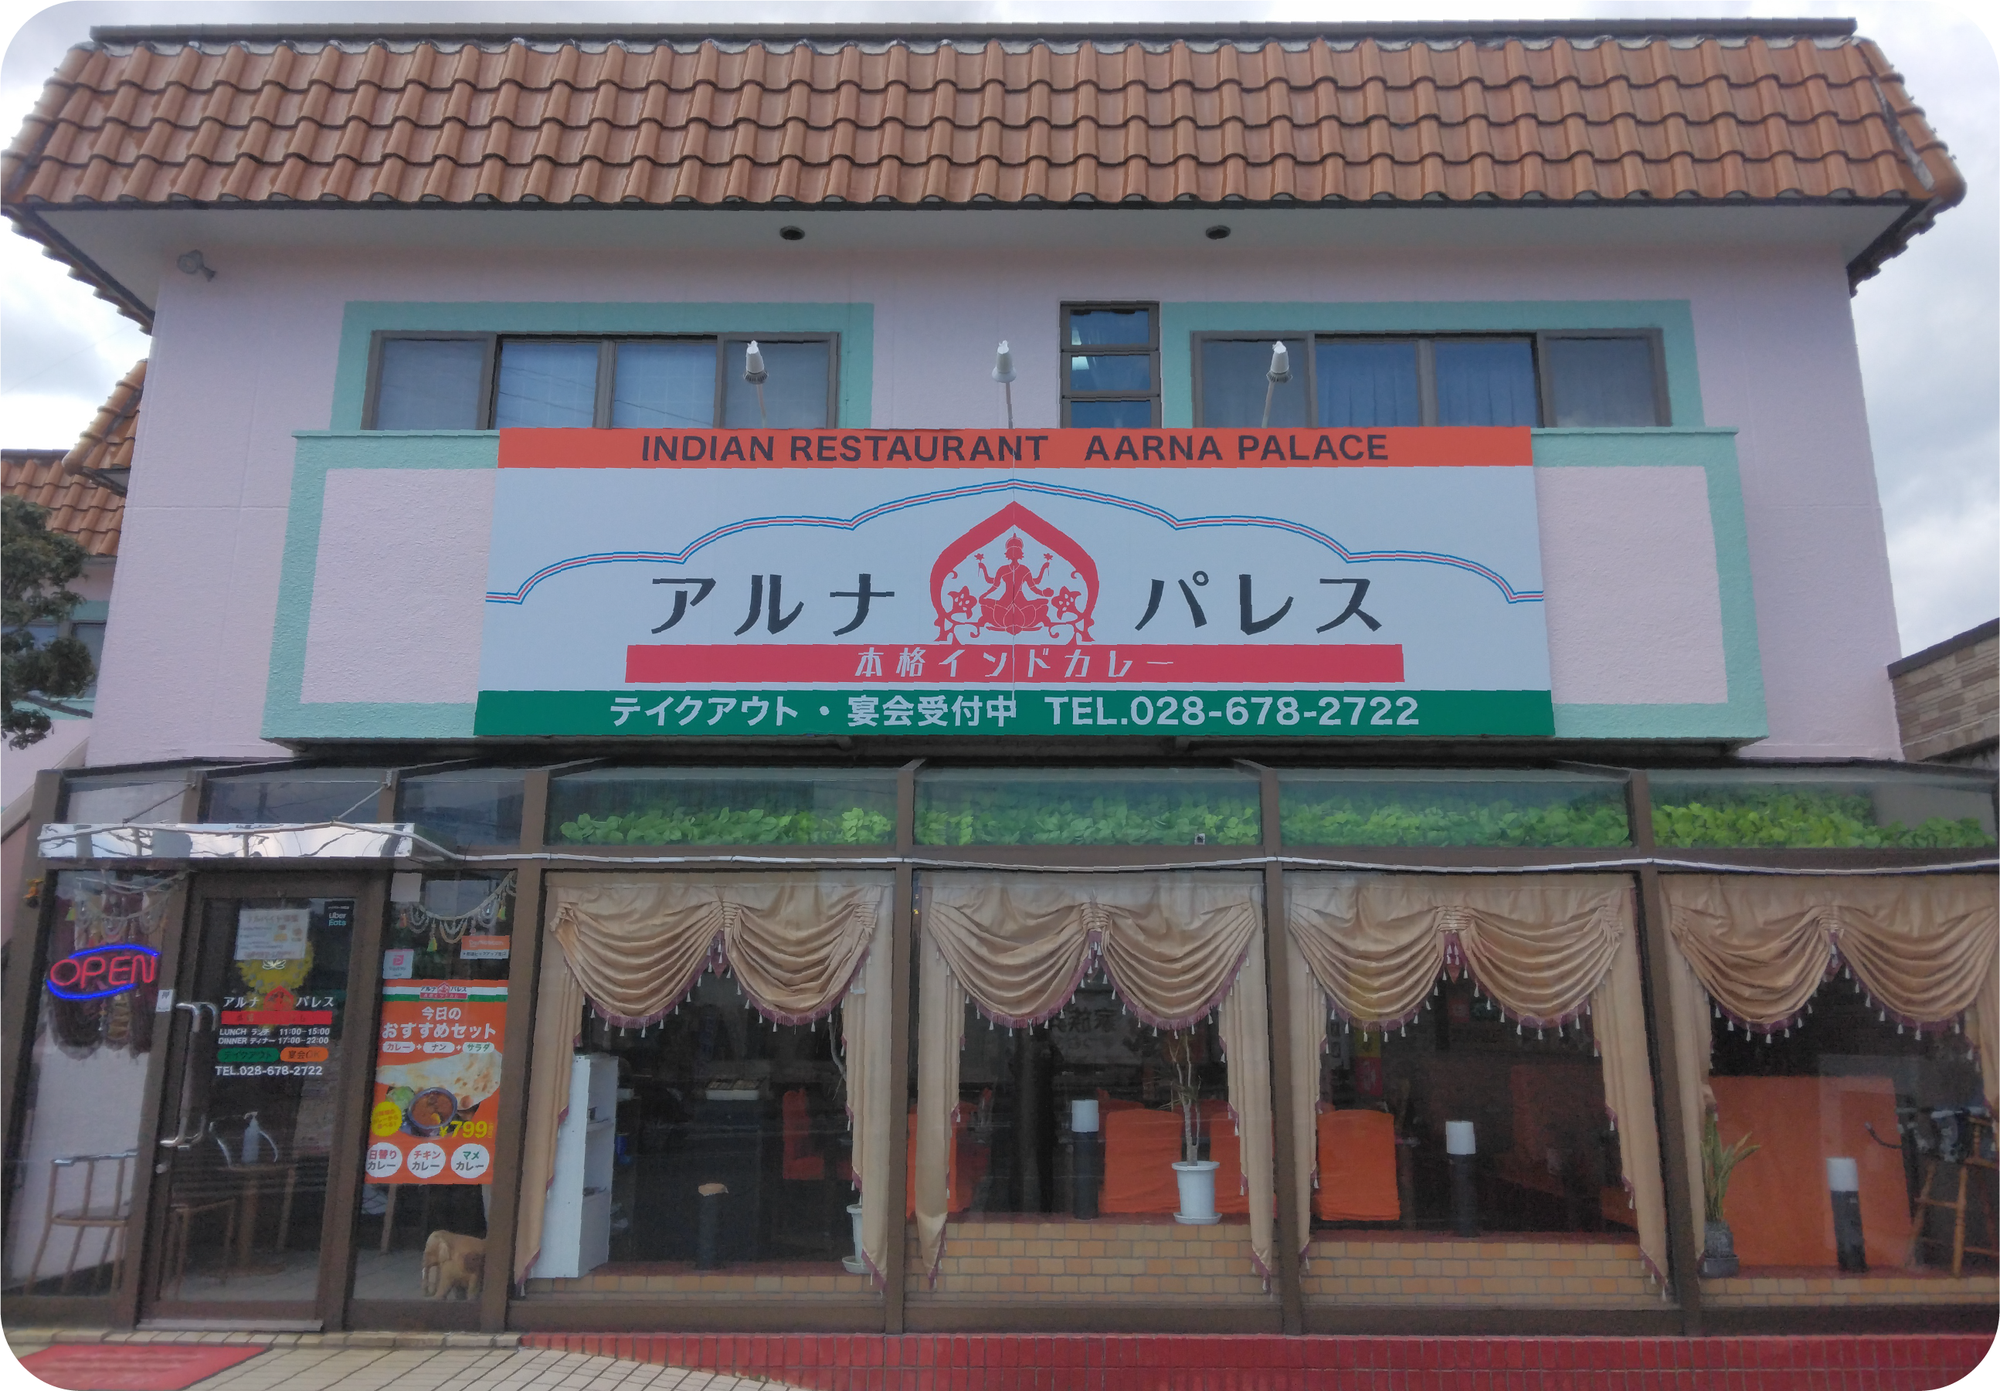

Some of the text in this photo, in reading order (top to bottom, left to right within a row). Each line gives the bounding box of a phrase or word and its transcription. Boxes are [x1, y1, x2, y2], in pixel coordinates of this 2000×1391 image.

[641, 434, 1389, 461] INDIAN RESTAURANT AARNA PALACE
[651, 571, 1383, 637] アルナ パレス
[855, 646, 1174, 679] 本格インドカレー
[1045, 696, 1420, 726] TEL.028-678-2722
[328, 911, 347, 919] Uber
[50, 954, 156, 989] OPEN
[223, 995, 335, 1009] アルナ パレス
[421, 1006, 462, 1020] 今日の
[219, 1028, 247, 1036] LUNCH
[381, 1022, 496, 1040] おすすめセット
[217, 1037, 248, 1045] DINNER
[386, 1042, 491, 1052] カレー ナン サラダ
[214, 1065, 323, 1077] TEL.028-678-2722
[439, 1120, 488, 1139] ¥799
[369, 1149, 398, 1160] 日替り
[413, 1150, 442, 1160] チキン
[462, 1150, 480, 1160] マメ
[367, 1160, 397, 1171] カレー
[411, 1161, 441, 1172] カレー
[455, 1161, 485, 1172] カレー
